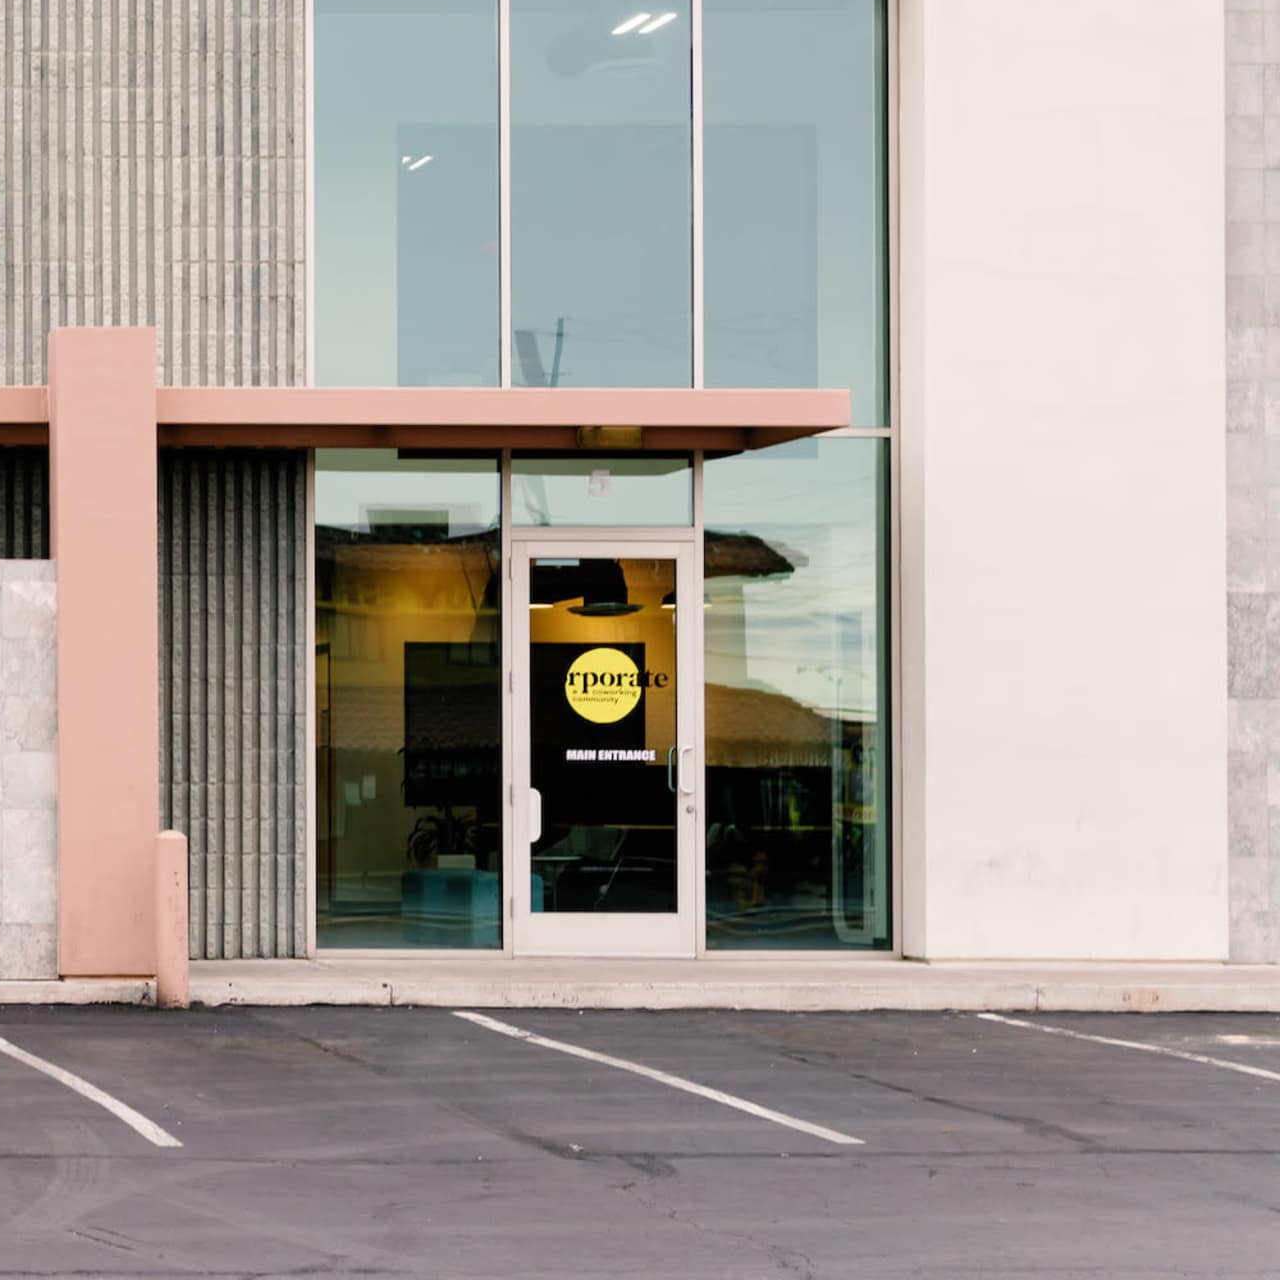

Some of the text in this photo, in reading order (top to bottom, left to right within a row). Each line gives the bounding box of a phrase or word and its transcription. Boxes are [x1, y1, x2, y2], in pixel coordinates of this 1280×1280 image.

[589, 469, 611, 496] 5
[566, 669, 669, 694] rporate
[592, 688, 637, 697] coworking
[566, 749, 656, 761] MAIN ENTRANCE
